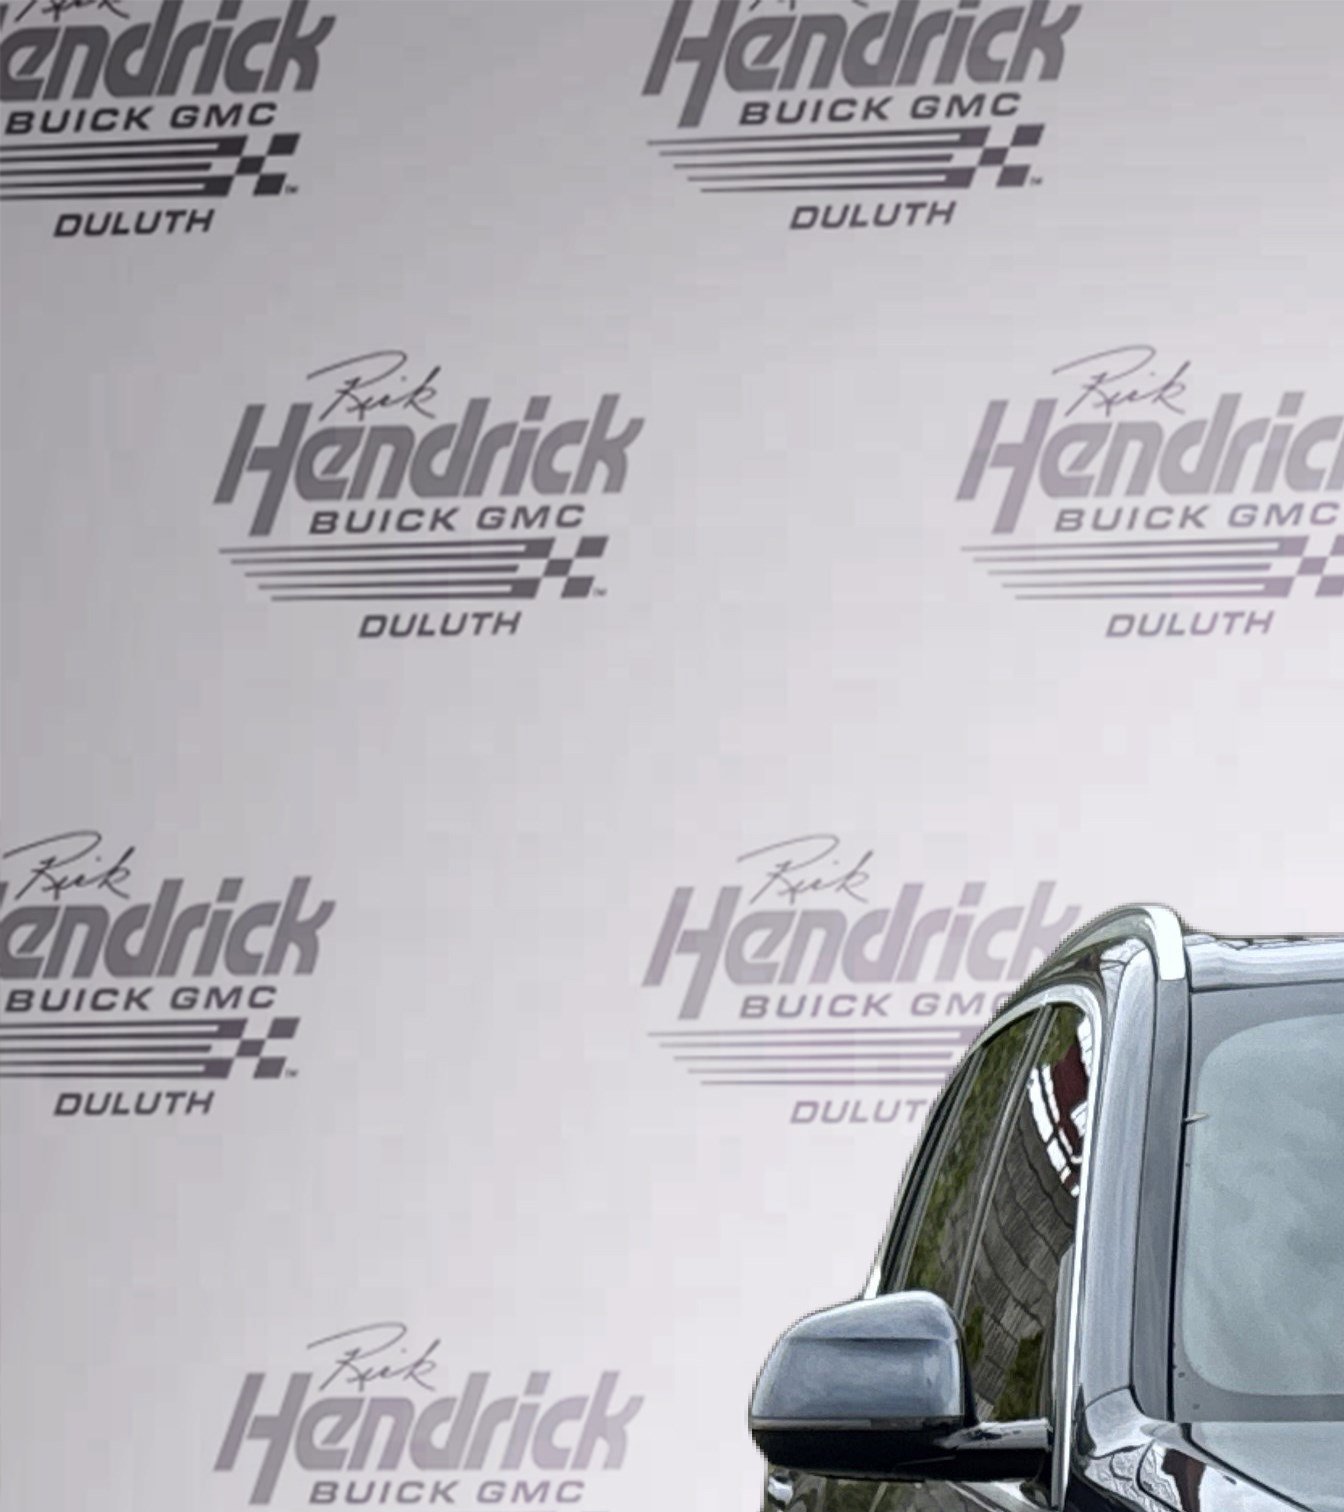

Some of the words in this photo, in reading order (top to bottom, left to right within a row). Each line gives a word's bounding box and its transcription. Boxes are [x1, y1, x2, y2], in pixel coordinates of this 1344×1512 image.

[0, 0, 336, 102] endrick
[5, 106, 153, 135] BUICK
[170, 102, 277, 129] GMC
[739, 97, 892, 126] BUICK
[910, 92, 1021, 119] GMC
[53, 209, 215, 237] DULUTH
[789, 201, 956, 230] DULUTH
[213, 394, 645, 535] Hendrick
[309, 508, 459, 535] BUICK
[476, 504, 585, 530] GMC
[1054, 505, 1209, 532] BUICK
[1228, 502, 1340, 528] GMC
[358, 611, 521, 638] DULUTH
[1105, 611, 1274, 638] DULUTH
[0, 876, 336, 977] endrick
[5, 987, 152, 1013] BUICK
[170, 986, 277, 1010] GMC
[739, 994, 891, 1019] BUICK
[54, 1091, 214, 1116] DULUTH
[790, 1101, 930, 1124] DULUT
[213, 1371, 645, 1505] Hendrick
[308, 1481, 458, 1505] BUICK
[476, 1480, 584, 1504] GMC
